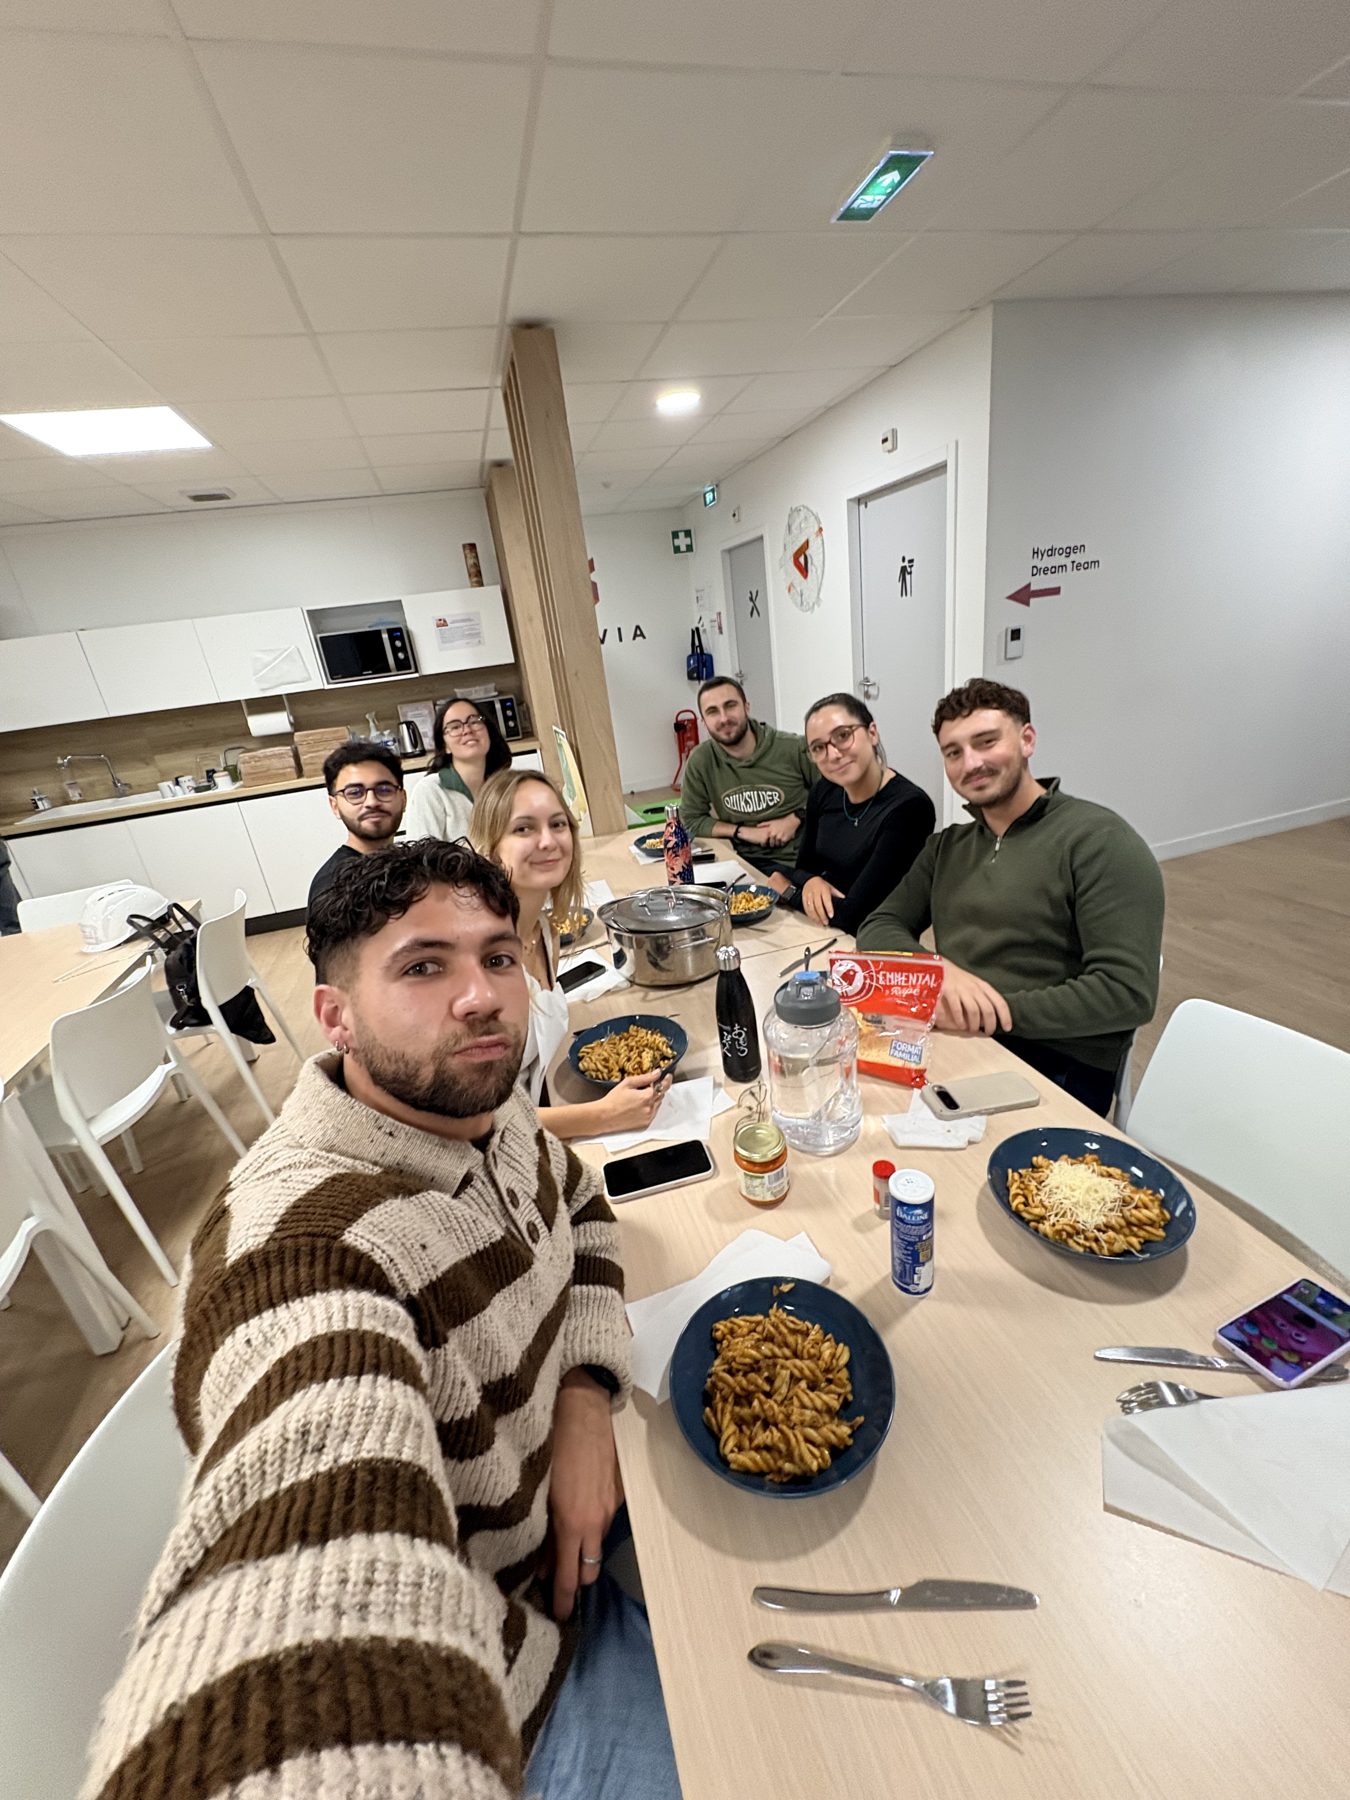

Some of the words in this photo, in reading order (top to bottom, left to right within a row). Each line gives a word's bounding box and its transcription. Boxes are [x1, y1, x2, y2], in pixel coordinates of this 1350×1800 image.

[1032, 544, 1086, 561] Hydrogen
[1031, 564, 1068, 577] Dream
[1070, 560, 1100, 572] Team
[724, 790, 780, 813] QUIKSILVER
[879, 970, 937, 988] EMMENTAL
